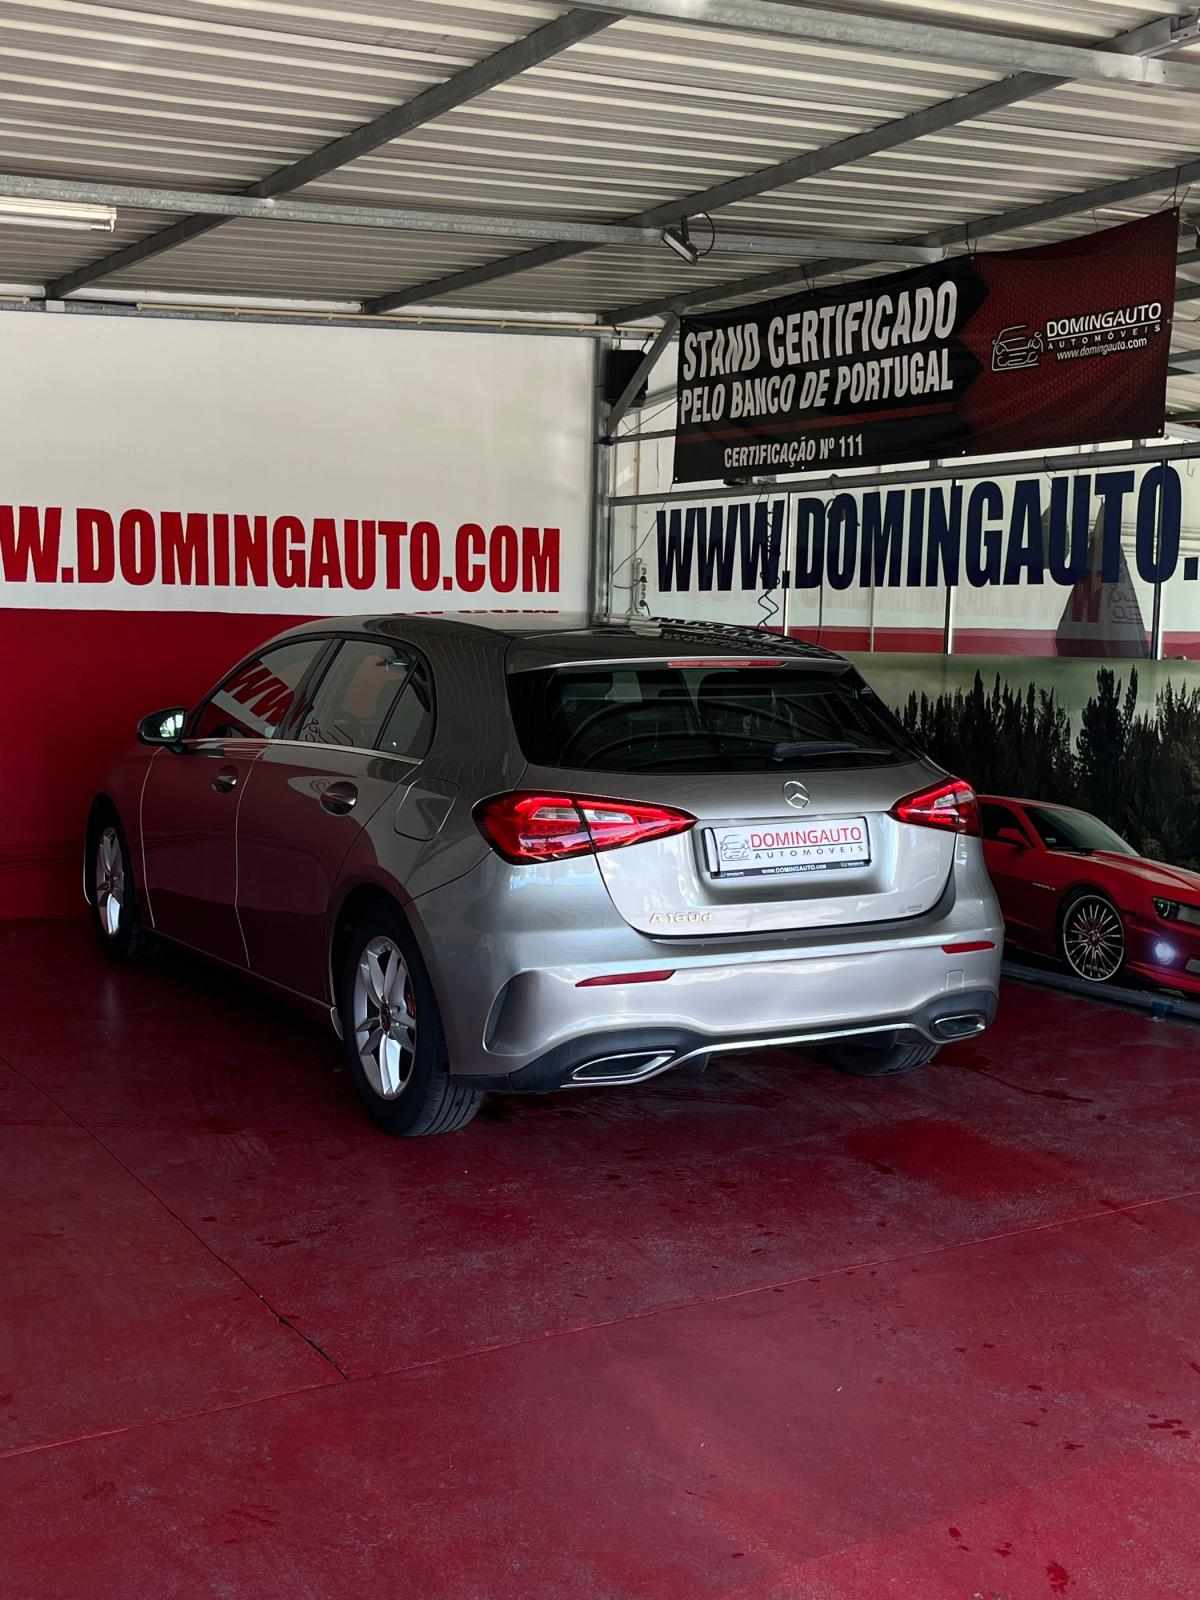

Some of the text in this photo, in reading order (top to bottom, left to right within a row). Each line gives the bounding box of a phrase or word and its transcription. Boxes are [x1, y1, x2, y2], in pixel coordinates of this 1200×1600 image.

[682, 280, 958, 381] STAND CERTIFICADO
[1046, 302, 1162, 337] DOMINGAUTO
[1047, 324, 1161, 350] AUTOMÓVEIS
[1056, 337, 1148, 360] www.domingauto.com
[680, 348, 953, 425] PELO BANCO DE PORTUGAL
[724, 436, 816, 468] CERTIFICAÇÃO
[839, 433, 863, 458] 111
[0, 504, 561, 593] W.DOMINGAUTO.COM
[750, 826, 862, 848] DOMINGAUTO
